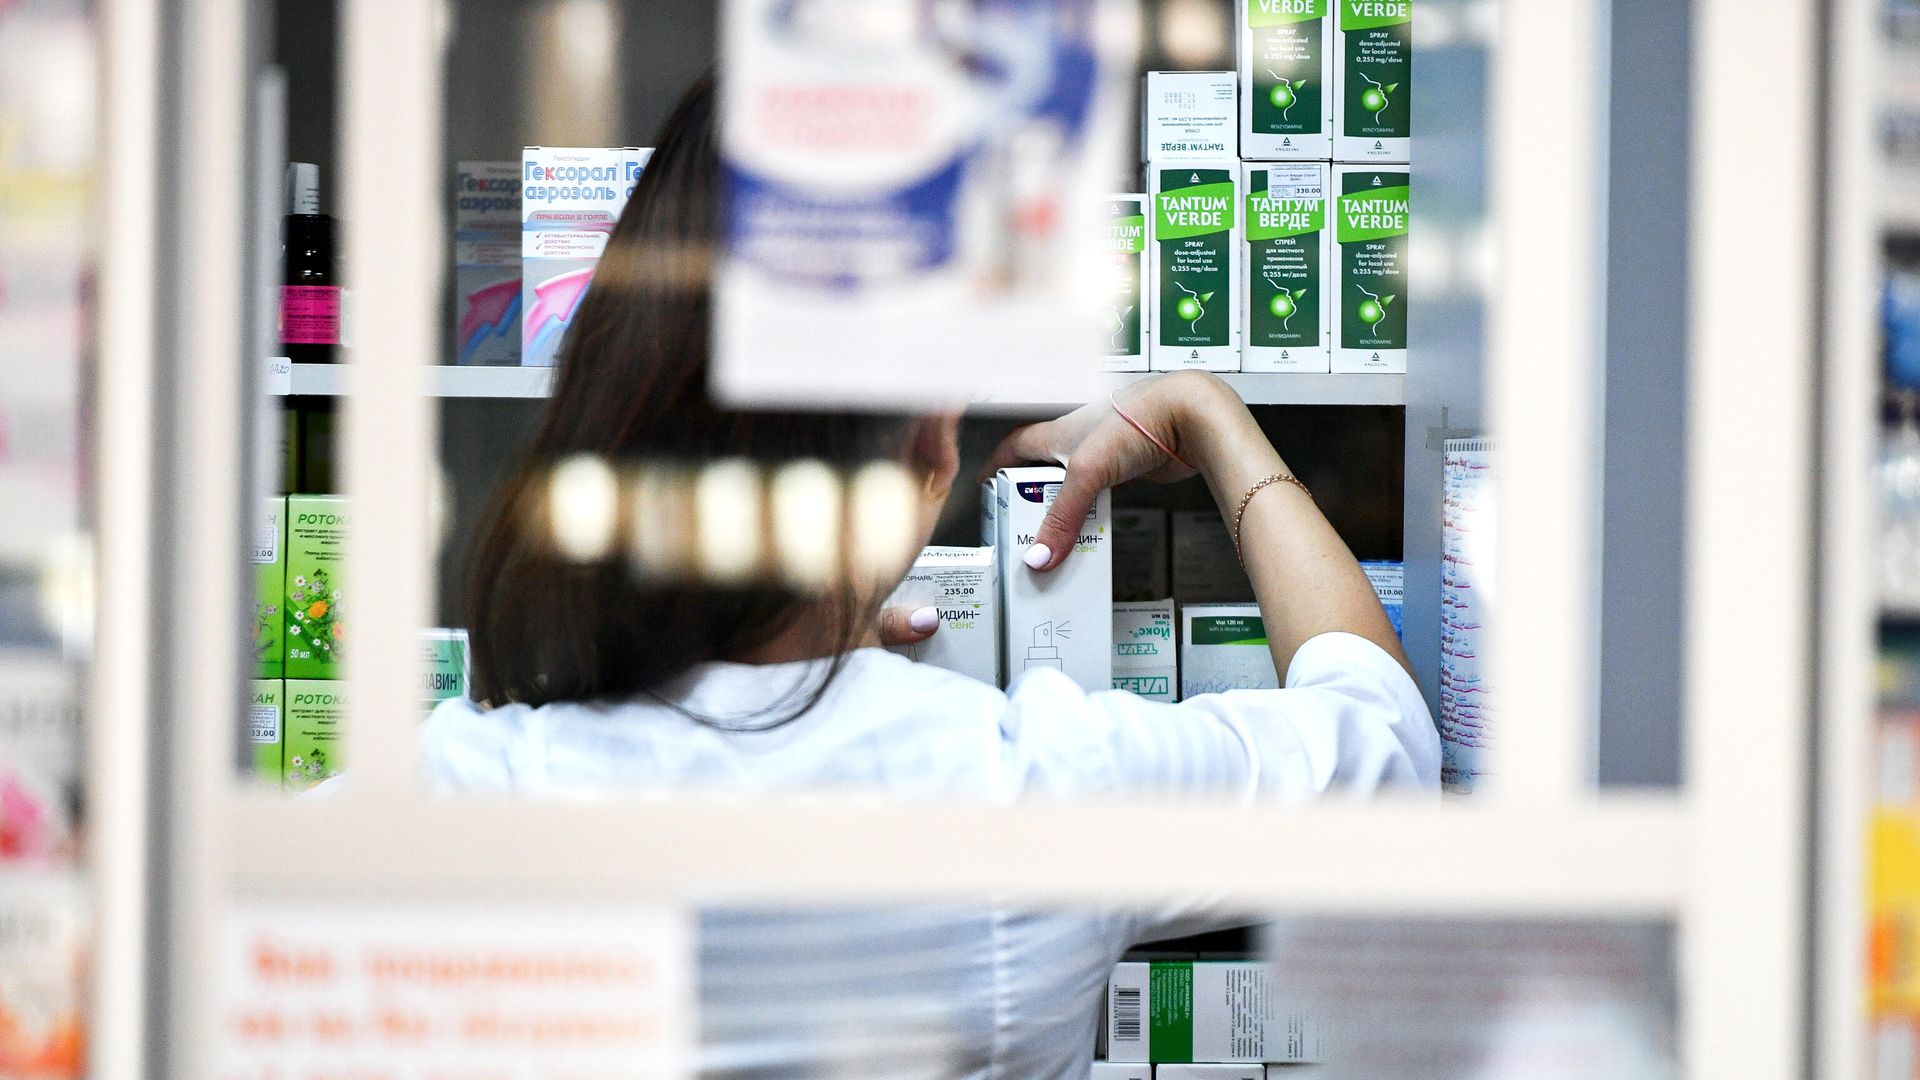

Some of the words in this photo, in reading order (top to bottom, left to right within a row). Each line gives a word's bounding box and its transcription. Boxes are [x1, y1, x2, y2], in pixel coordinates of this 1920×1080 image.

[1258, 0, 1314, 14] VERDE
[1351, 3, 1406, 16] VERDE
[1375, 56, 1402, 64] mg/dose
[1160, 143, 1187, 151] ВЕРДЕ
[1189, 143, 1224, 151] ТАНТУМ
[525, 161, 617, 185] Гексорал
[525, 185, 617, 203] аэрозоль
[1160, 197, 1228, 211] TANTUM
[1251, 198, 1319, 212] ТАНТУМ
[1342, 200, 1409, 213] TANTUM
[1166, 212, 1222, 226] VERDE
[1259, 213, 1310, 230] ВЕРДЕ
[1348, 215, 1403, 229] VERDE
[949, 621, 975, 629] сенс
[290, 649, 299, 658] 50
[1118, 643, 1157, 655] TEVA
[422, 673, 457, 690] ЛАВИН
[1113, 677, 1168, 695] TEVA
